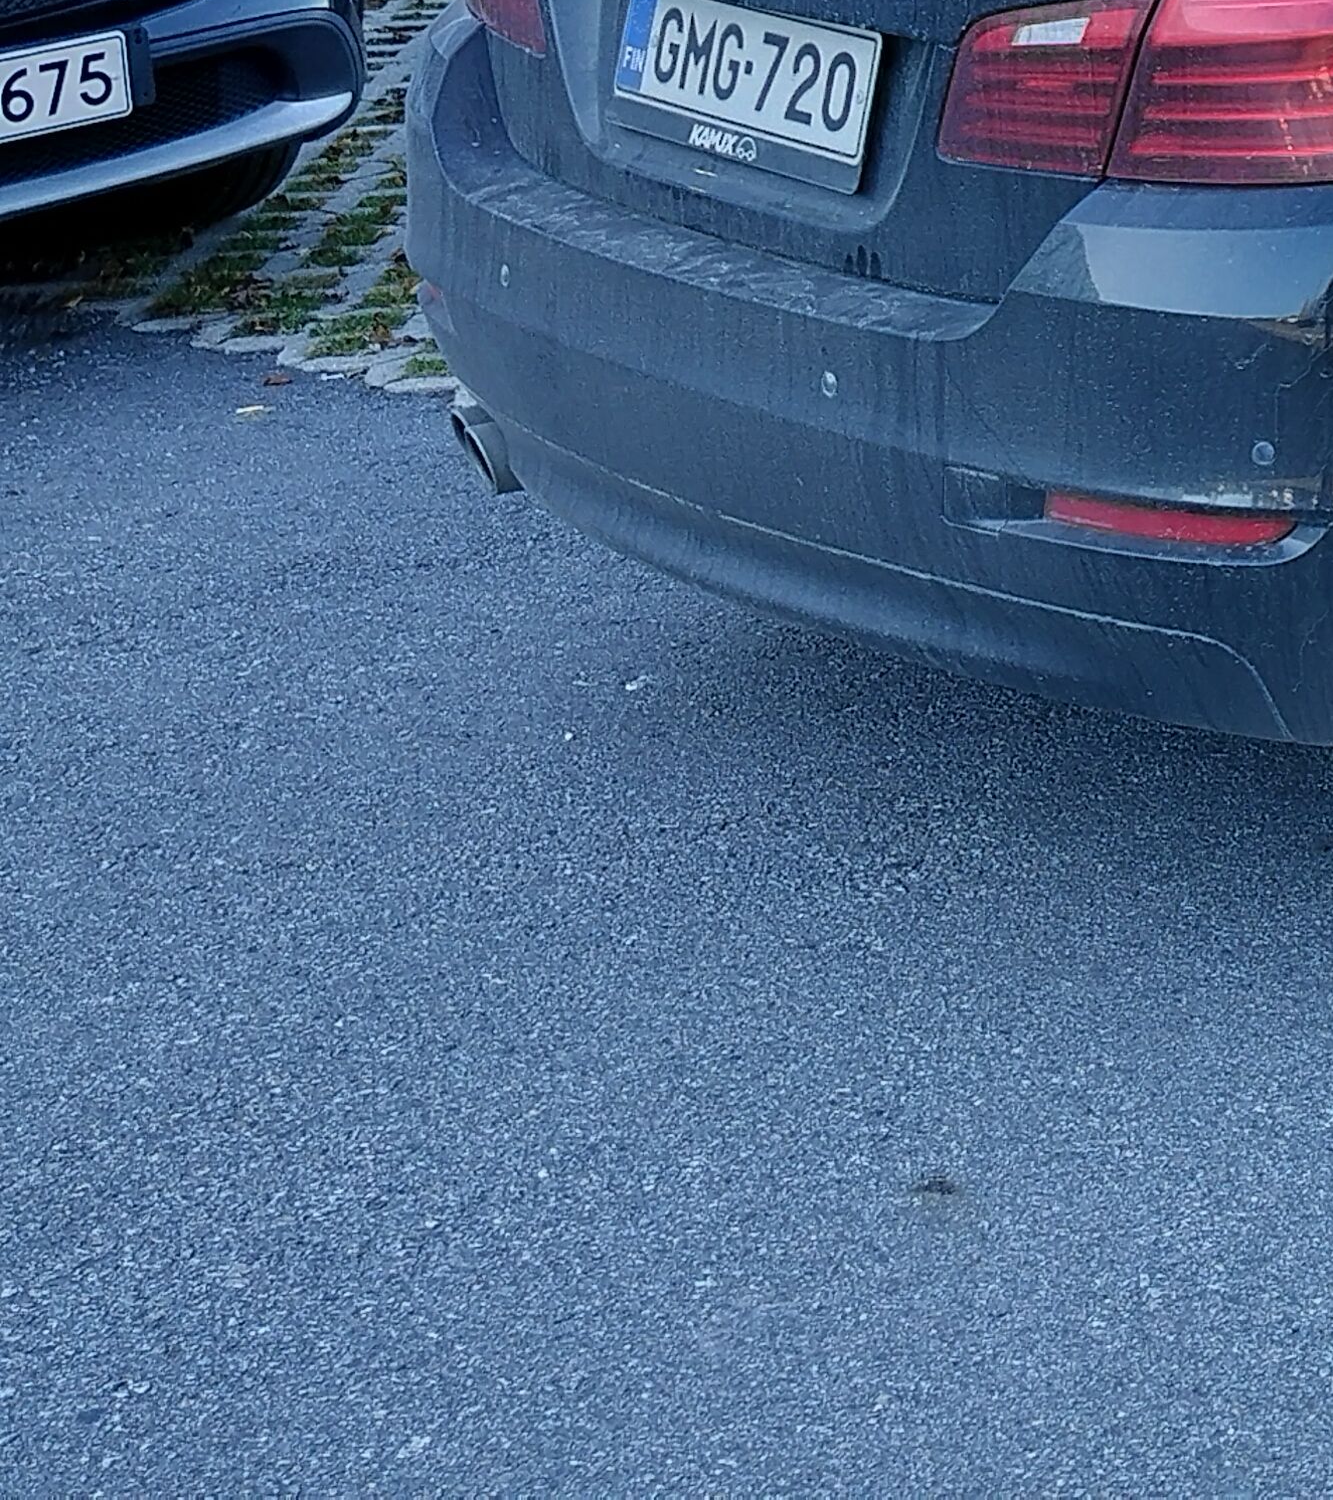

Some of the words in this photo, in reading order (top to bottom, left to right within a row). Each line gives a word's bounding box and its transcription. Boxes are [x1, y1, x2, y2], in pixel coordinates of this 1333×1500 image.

[622, 44, 646, 74] FIN
[653, 7, 857, 132] GMG-720
[687, 122, 740, 156] KAMUX
